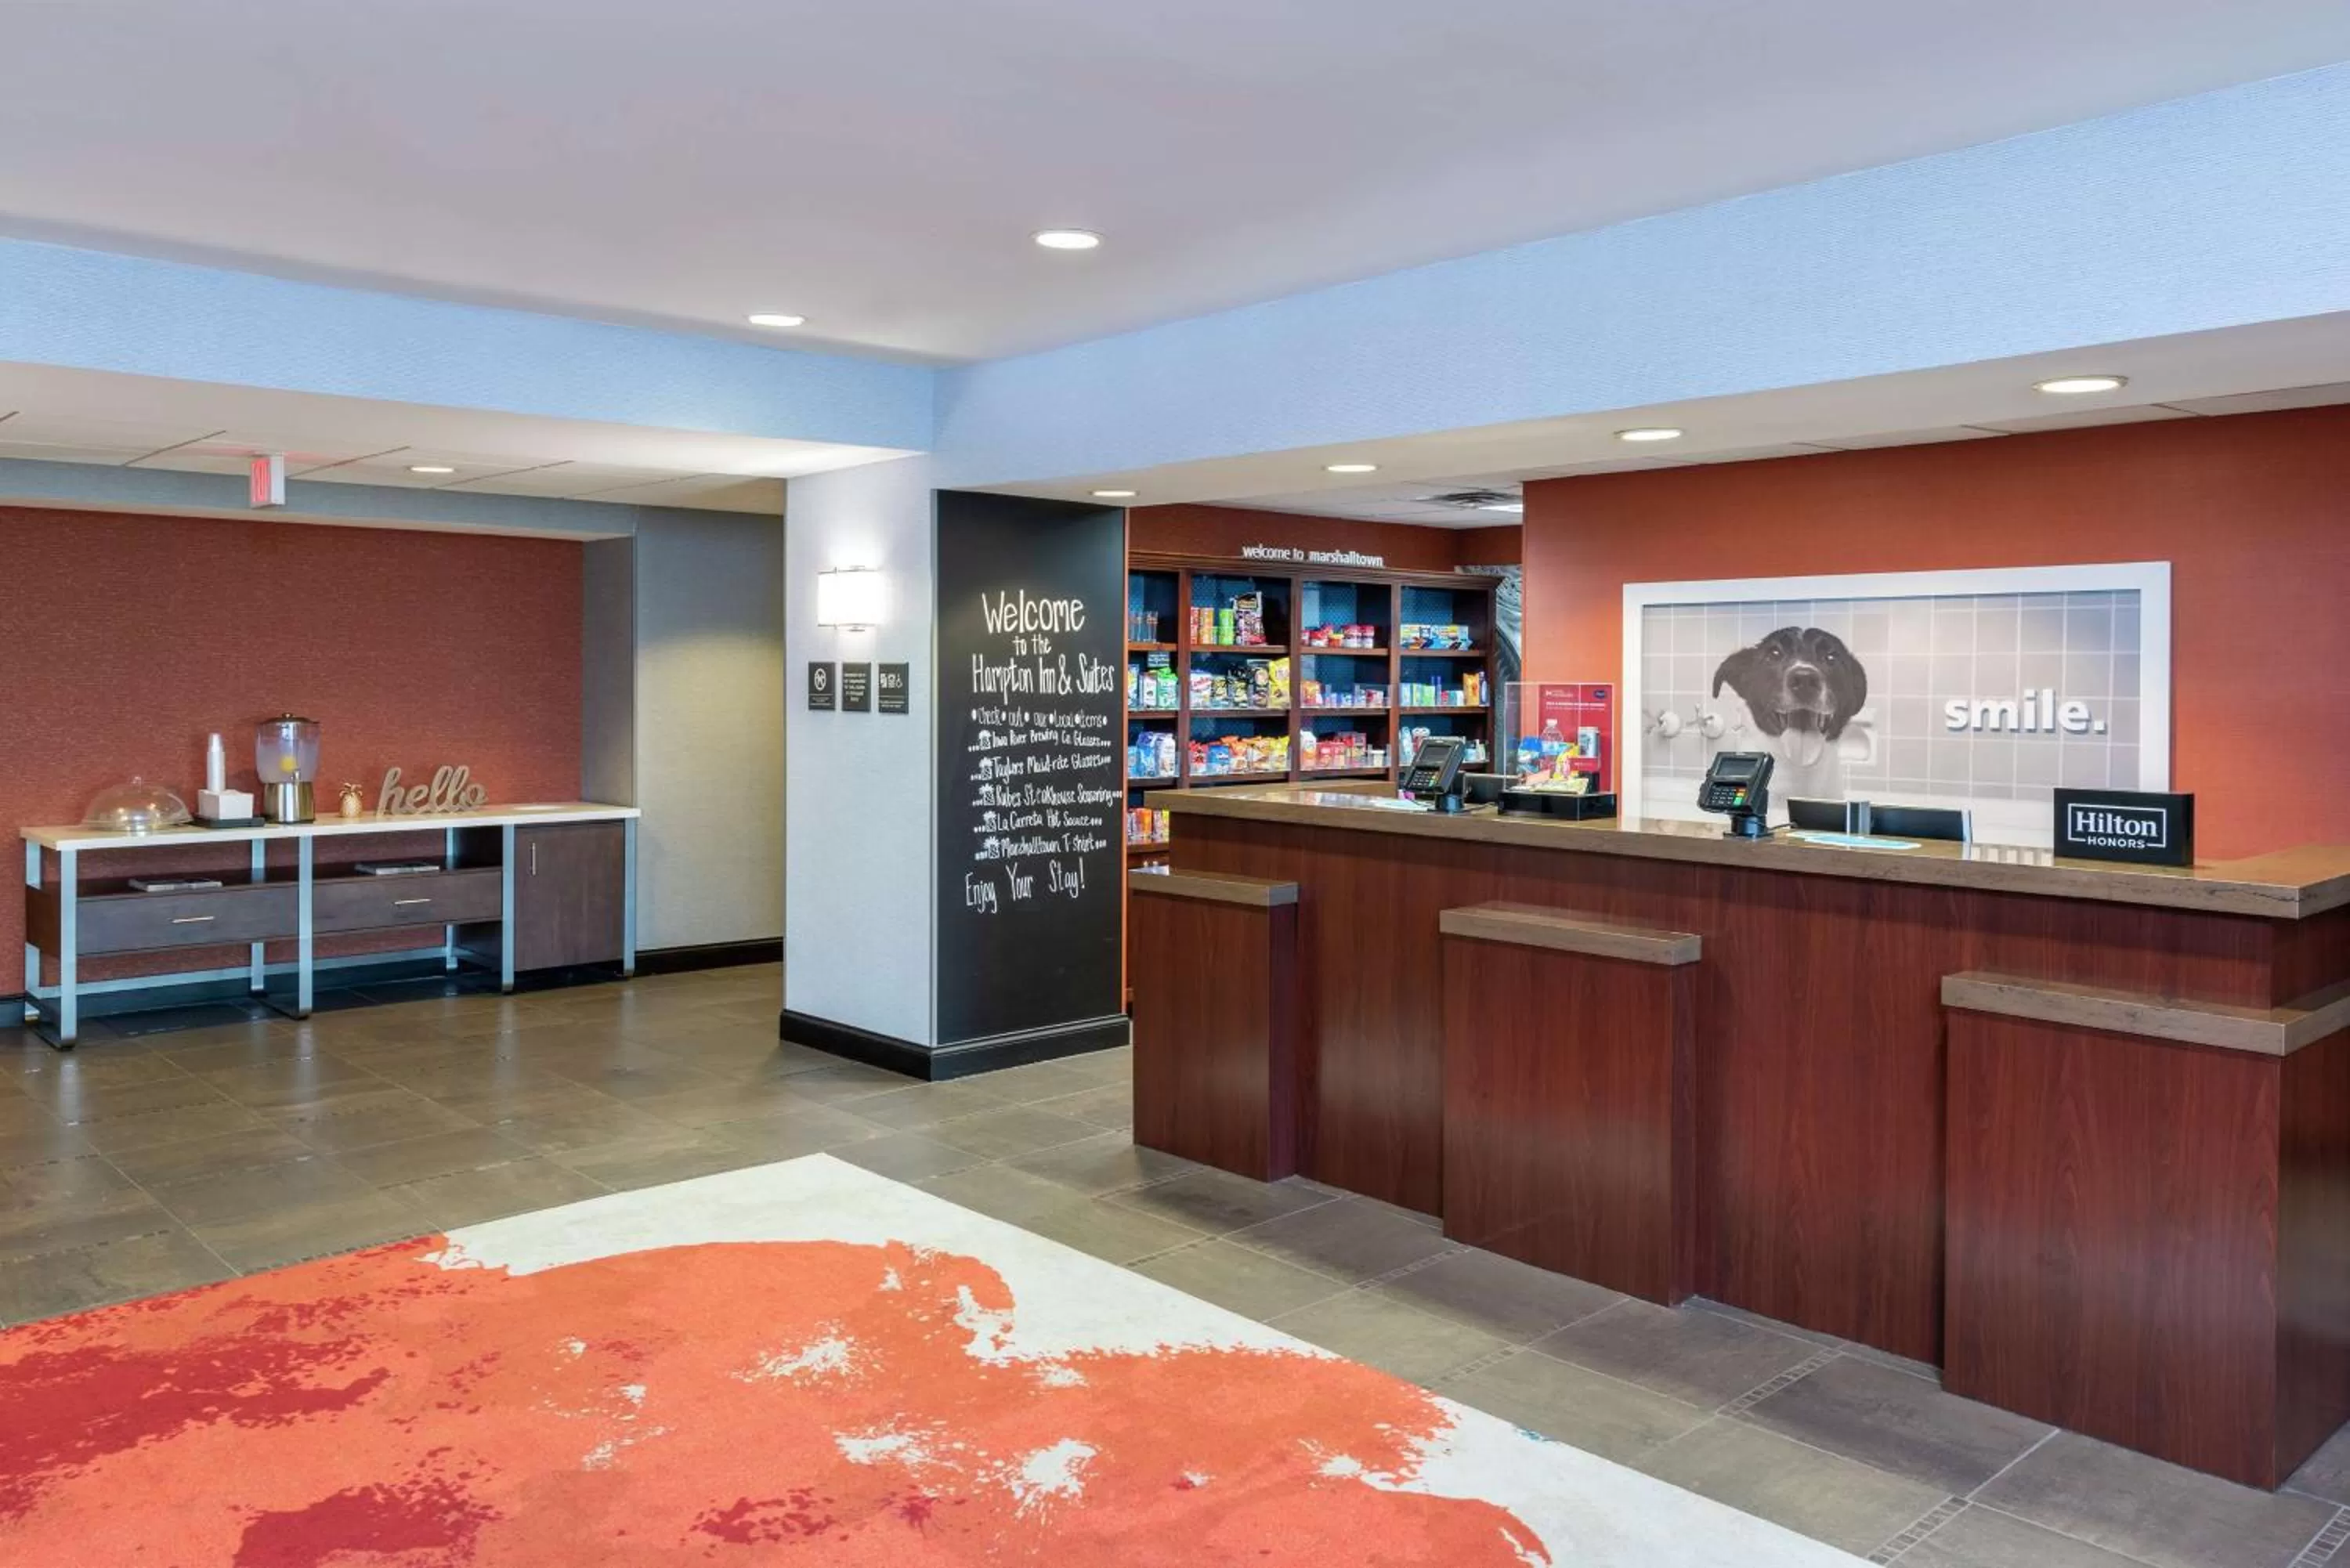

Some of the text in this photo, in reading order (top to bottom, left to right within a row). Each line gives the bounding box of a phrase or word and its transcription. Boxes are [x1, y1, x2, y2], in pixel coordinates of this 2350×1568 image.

[1242, 544, 1384, 568] welcome to marshalltown
[982, 588, 1086, 634] Welcome
[1012, 633, 1052, 656] to the
[971, 652, 1115, 706] Hampton Inn & Suites
[1008, 705, 1025, 727] out
[1033, 711, 1048, 728] our
[1943, 688, 2107, 734] smile.
[376, 764, 490, 818] hello
[997, 812, 1010, 832] La
[2075, 811, 2158, 837] Hilton
[2087, 836, 2146, 849] HONORS
[965, 856, 1086, 914] Enjoy Your Stay!
